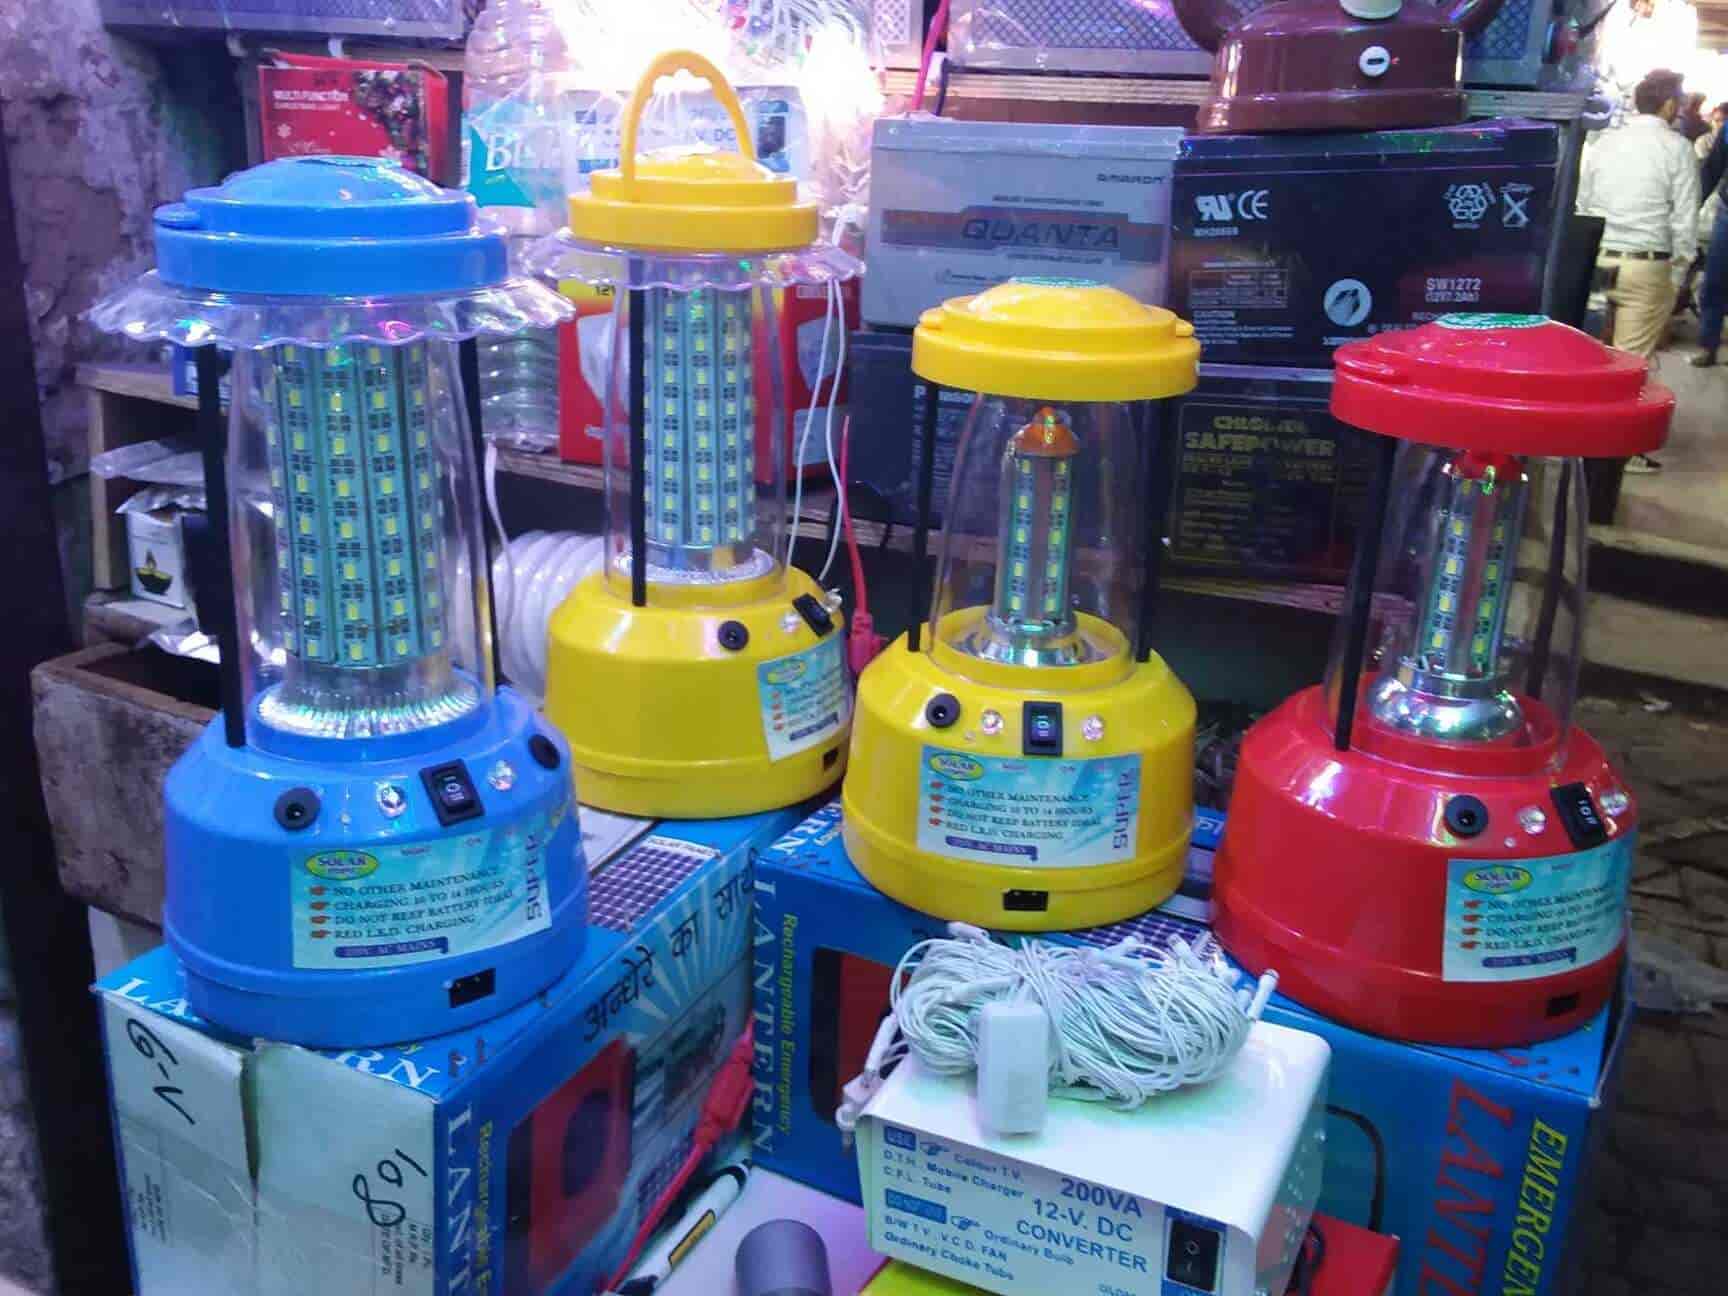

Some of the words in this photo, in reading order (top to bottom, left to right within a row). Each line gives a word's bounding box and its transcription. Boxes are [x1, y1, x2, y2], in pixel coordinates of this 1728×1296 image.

[962, 219, 1119, 249] QUANTA
[753, 880, 777, 1152] LANTERN
[972, 1175, 1025, 1199] Charger
[1060, 1177, 1143, 1219] 200VA
[1097, 1216, 1134, 1243] DC
[981, 1244, 1008, 1263] FAN
[1016, 1219, 1148, 1273] CONVERTER
